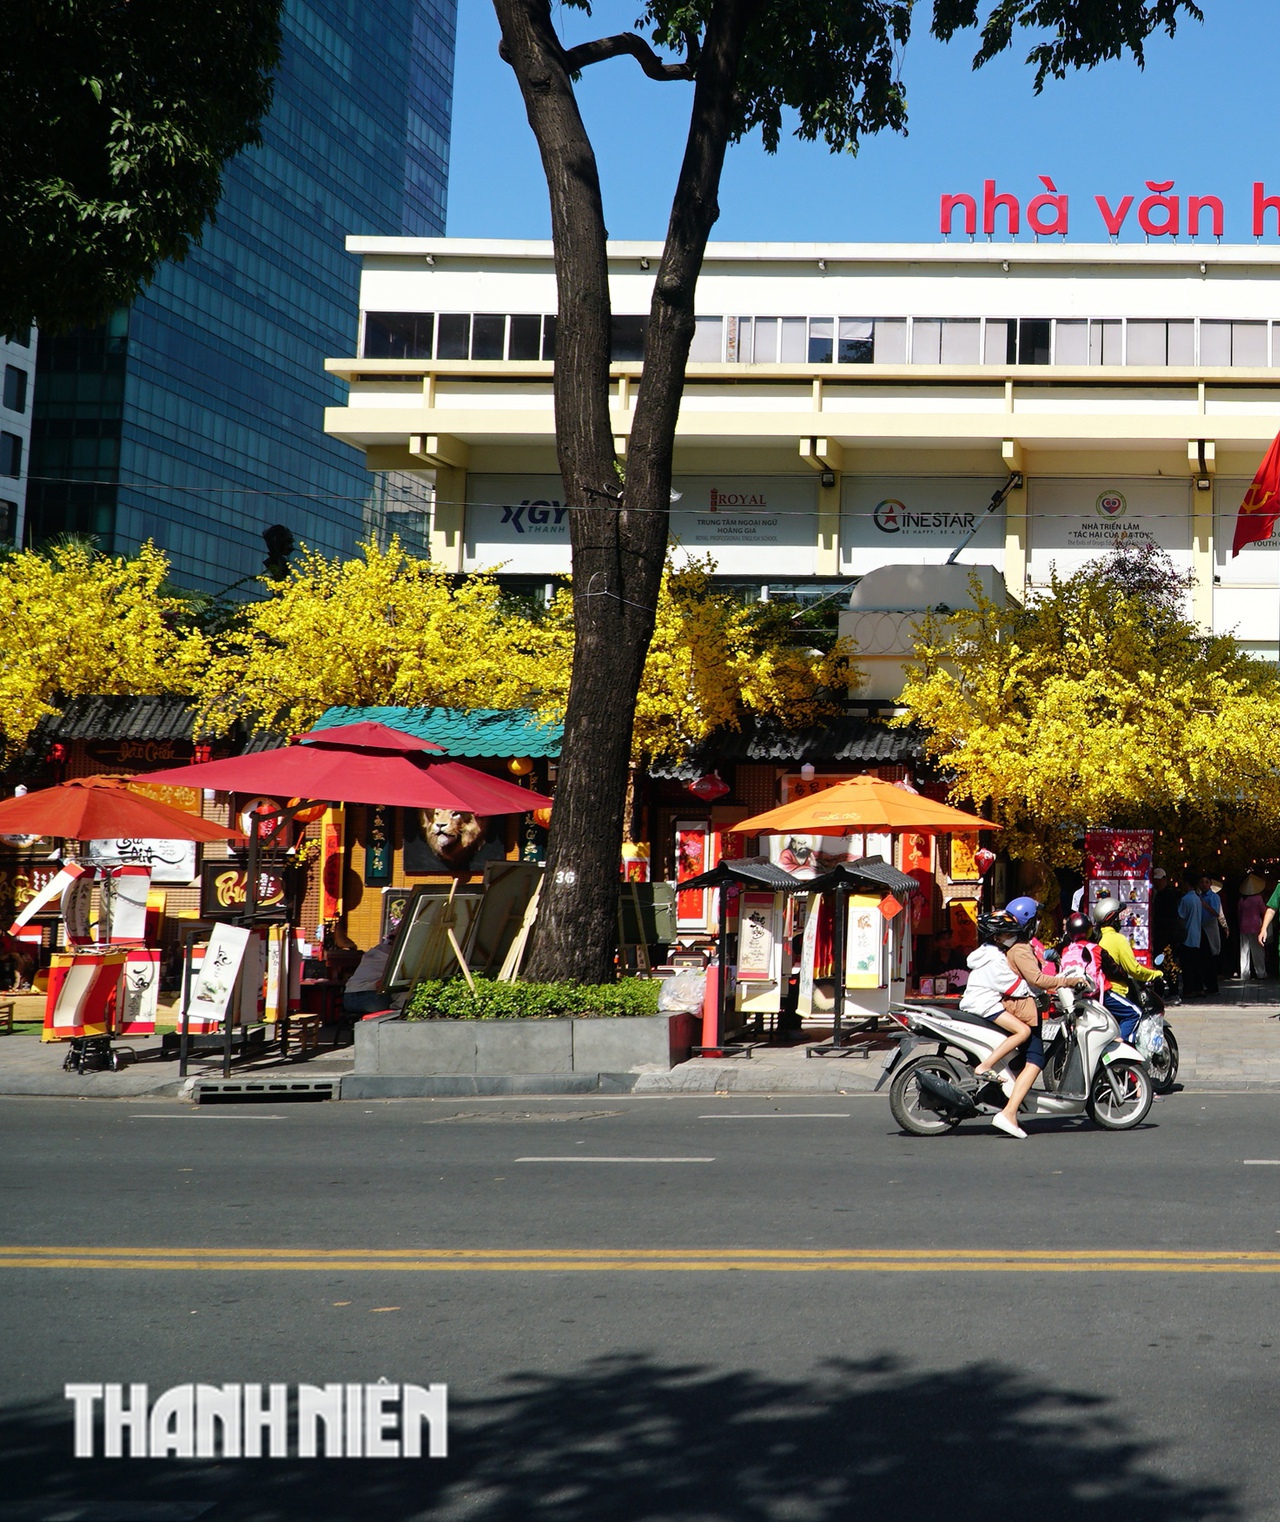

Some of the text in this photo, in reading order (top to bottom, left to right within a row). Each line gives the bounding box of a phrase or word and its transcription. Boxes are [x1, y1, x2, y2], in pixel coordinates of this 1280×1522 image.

[940, 175, 1068, 235] nhà
[1094, 180, 1224, 236] văn
[718, 494, 767, 505] ROYAL
[722, 518, 737, 526] TÂM
[738, 519, 761, 527] NGOẠI
[1081, 522, 1099, 530] NHÀ
[1088, 530, 1103, 540] HẠI
[556, 870, 575, 884] 36
